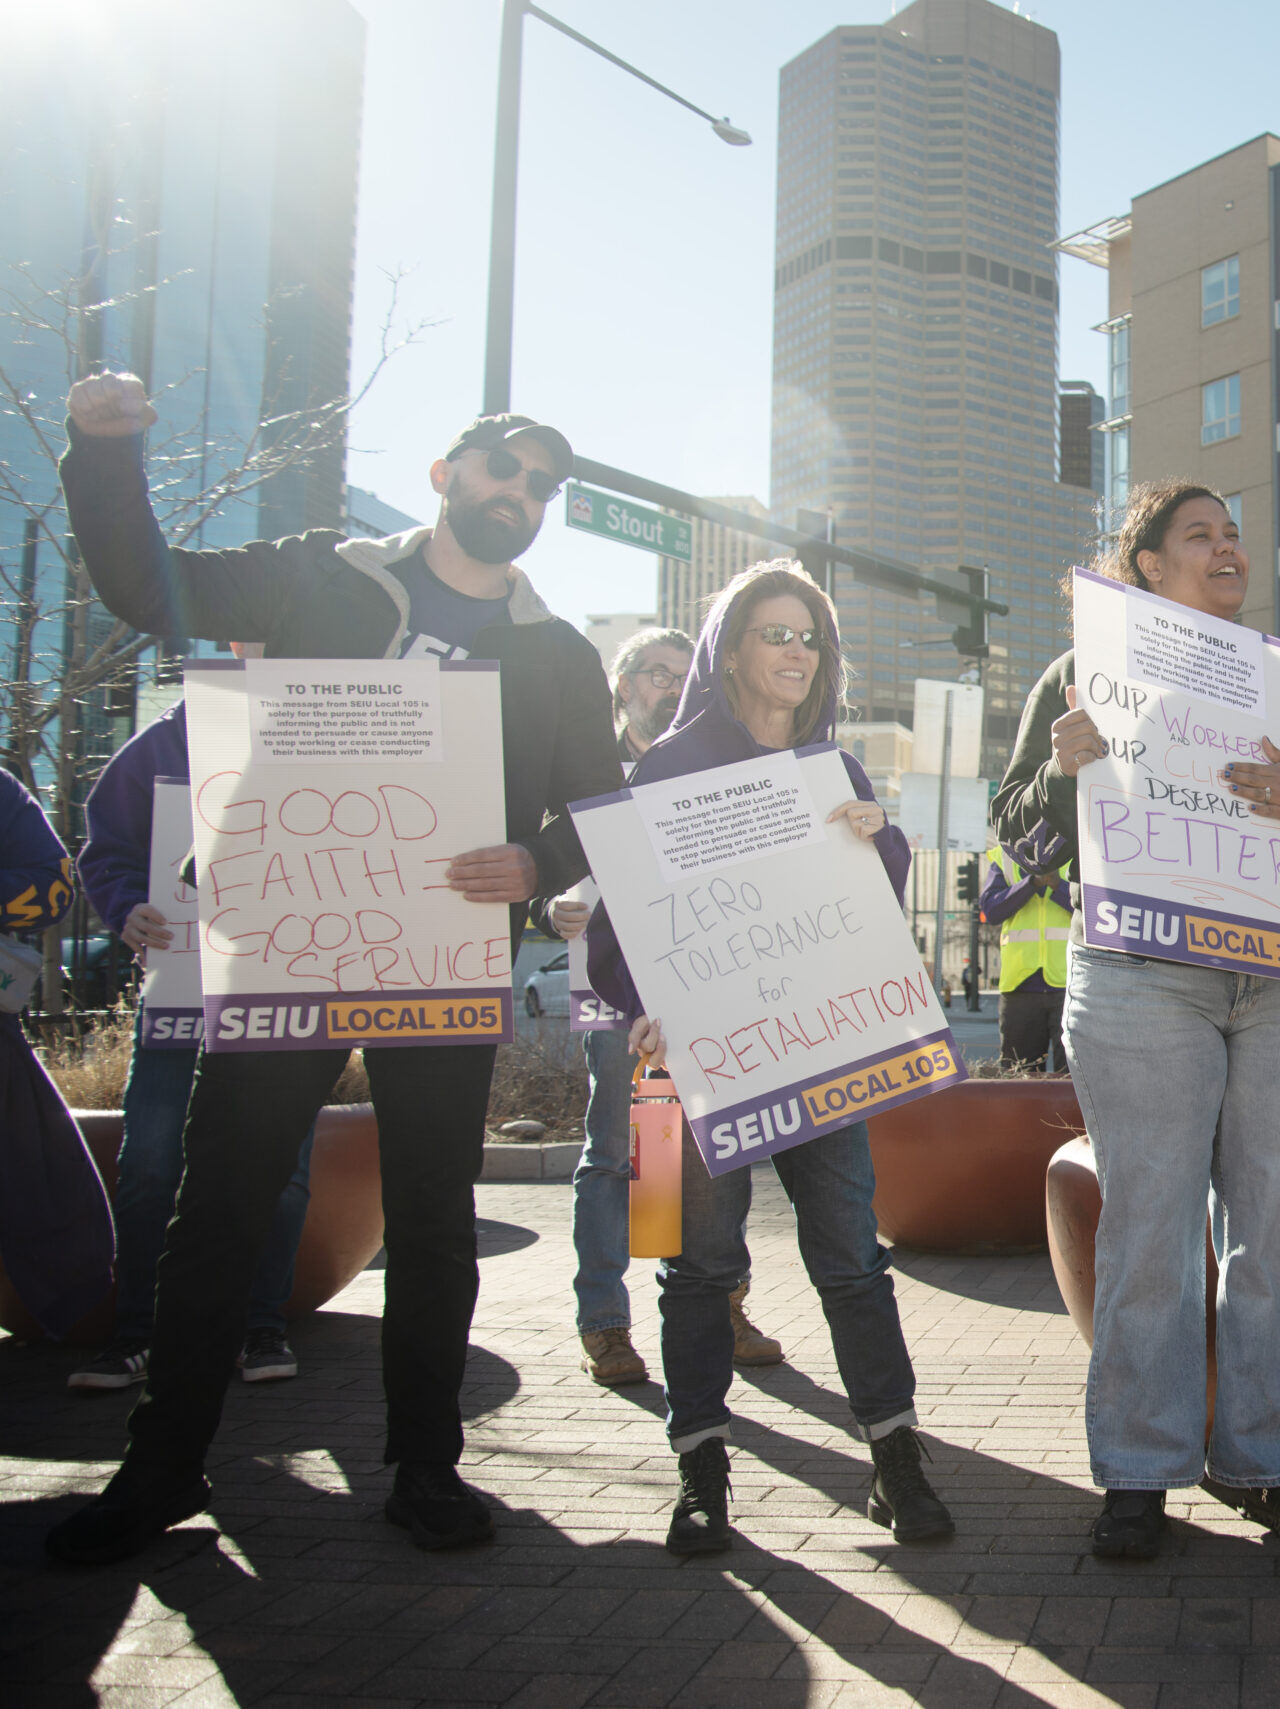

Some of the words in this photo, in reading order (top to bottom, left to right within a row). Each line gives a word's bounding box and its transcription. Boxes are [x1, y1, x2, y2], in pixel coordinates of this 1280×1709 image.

[606, 503, 664, 545] Stout
[1153, 616, 1168, 629] TO
[1172, 622, 1194, 638] THE
[1197, 632, 1236, 653] PUBLIC
[282, 701, 324, 709] message
[285, 684, 306, 694] TO
[310, 684, 342, 694] THE
[346, 684, 402, 694] PUBLIC
[1088, 672, 1155, 725] OUR
[1159, 694, 1272, 766] WORKER
[1102, 738, 1153, 773] UR
[1170, 734, 1190, 747] AND
[198, 771, 437, 840] GOOD
[654, 819, 673, 828] This
[674, 810, 711, 823] message
[711, 805, 731, 814] from
[731, 798, 751, 809] SEIU
[752, 793, 775, 804] Local
[775, 789, 790, 798] 105
[671, 799, 691, 811] TO
[694, 791, 722, 805] THE
[724, 778, 772, 798] PUBLIC
[1144, 777, 1251, 819] DESERVE
[208, 848, 405, 906] FAITH
[648, 877, 763, 946] ZERO
[1095, 899, 1180, 946] SEIU
[1188, 922, 1275, 961] LOCAL
[206, 907, 402, 962] GOOD
[654, 898, 863, 993] TOLERANCE
[287, 937, 512, 999] SERVICE
[758, 976, 793, 1003] for
[151, 1017, 204, 1041] SEI
[217, 1005, 320, 1040] SEIU
[331, 1008, 436, 1032] LOCAL
[441, 1006, 498, 1029] 105
[689, 971, 928, 1094] RETALIATION
[710, 1097, 803, 1160] SEIU
[808, 1066, 902, 1119] LOCAL
[902, 1048, 950, 1084] 105
